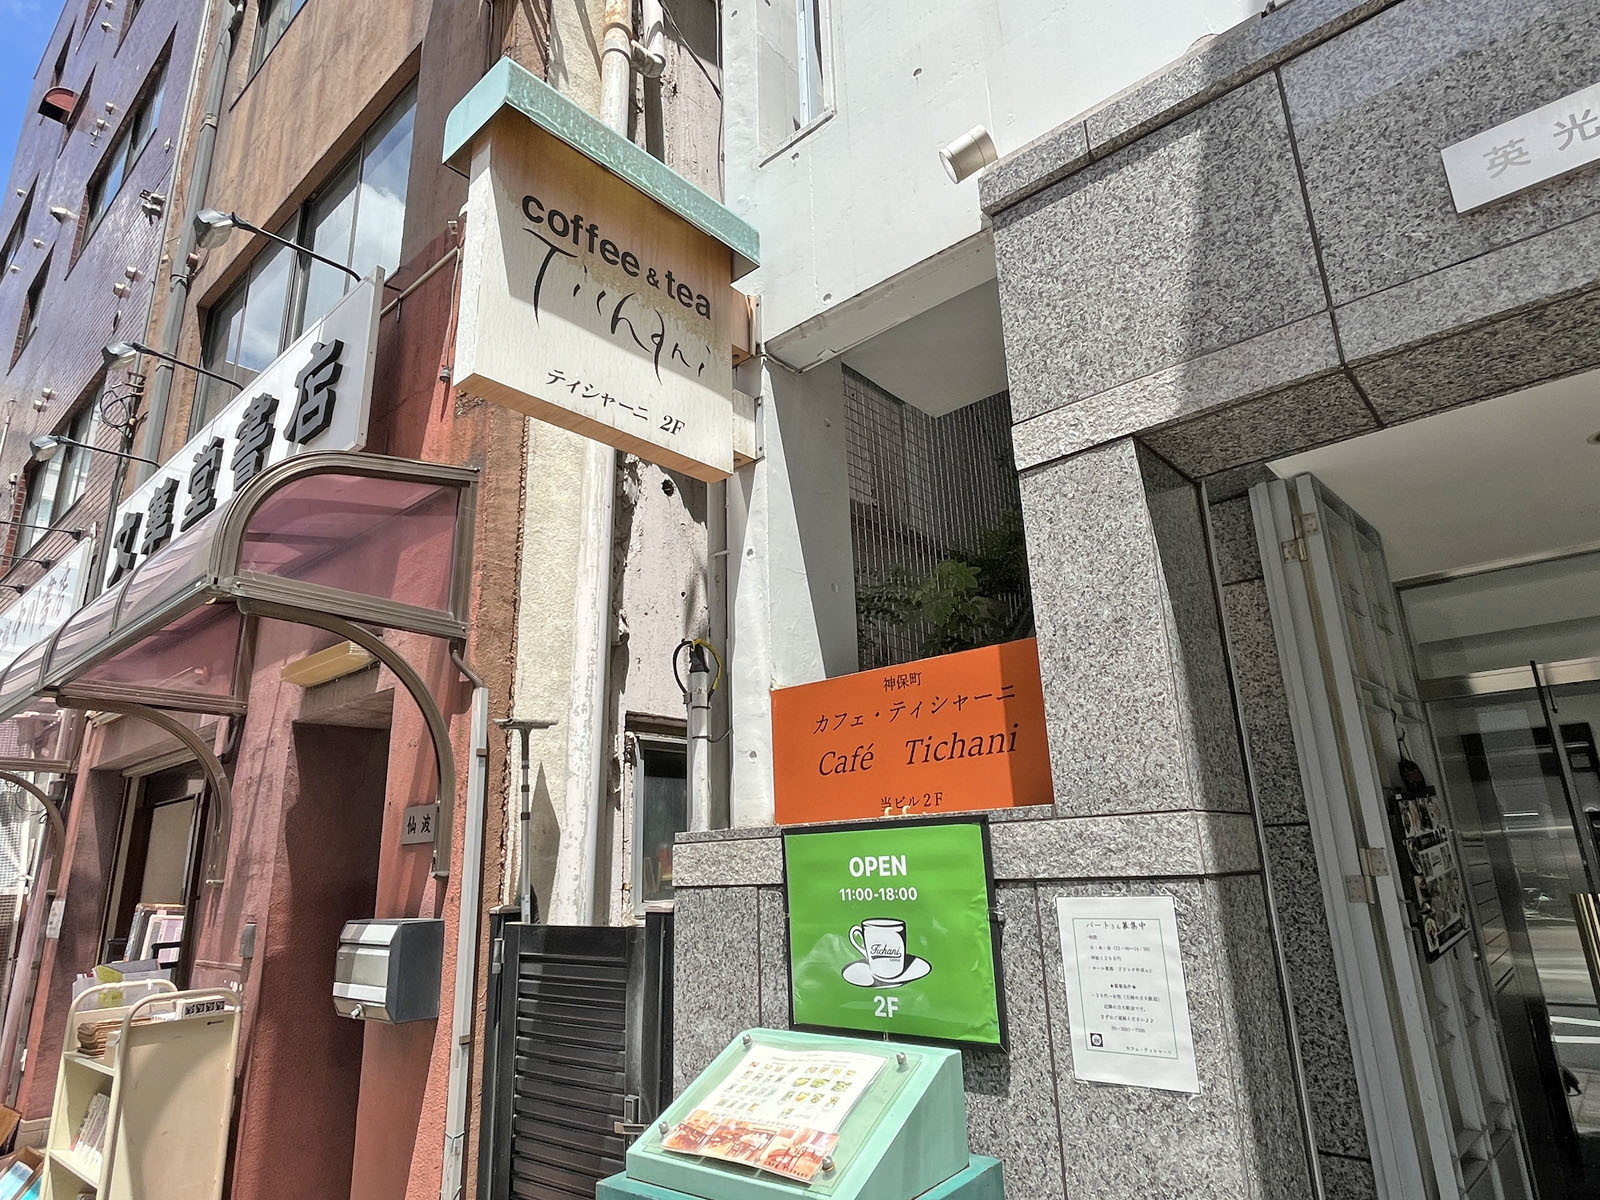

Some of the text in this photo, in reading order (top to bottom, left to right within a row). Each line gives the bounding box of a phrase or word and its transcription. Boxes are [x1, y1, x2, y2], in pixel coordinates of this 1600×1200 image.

[1482, 109, 1600, 179] 英光
[522, 194, 712, 320] coffee & tea
[546, 368, 686, 436] ティシャーニ 2F
[107, 338, 345, 588] 文華堂書店
[883, 671, 922, 693] 神保町
[813, 684, 1016, 735] カフェ・ティシャーニ
[818, 723, 1019, 777] Café Tichani
[848, 855, 907, 878] OPEN
[839, 887, 918, 902] 11:00-18:00
[870, 943, 902, 959] Tichani
[873, 995, 899, 1018] 2F
